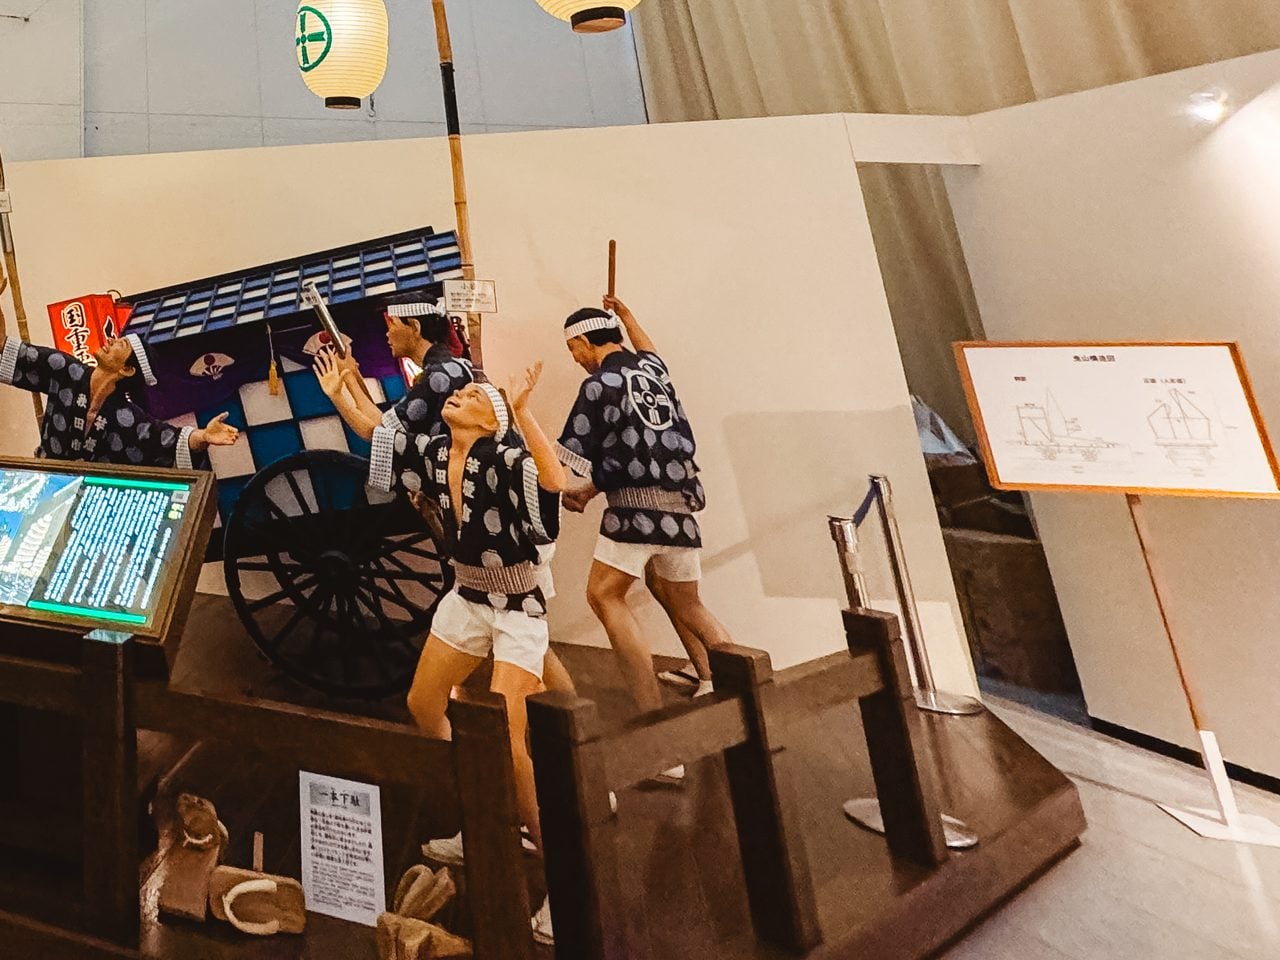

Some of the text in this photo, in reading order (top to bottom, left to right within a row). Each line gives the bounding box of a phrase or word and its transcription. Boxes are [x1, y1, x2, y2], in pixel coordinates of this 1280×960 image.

[435, 446, 450, 509] 秋田市
[318, 790, 361, 807] 一本下駄
